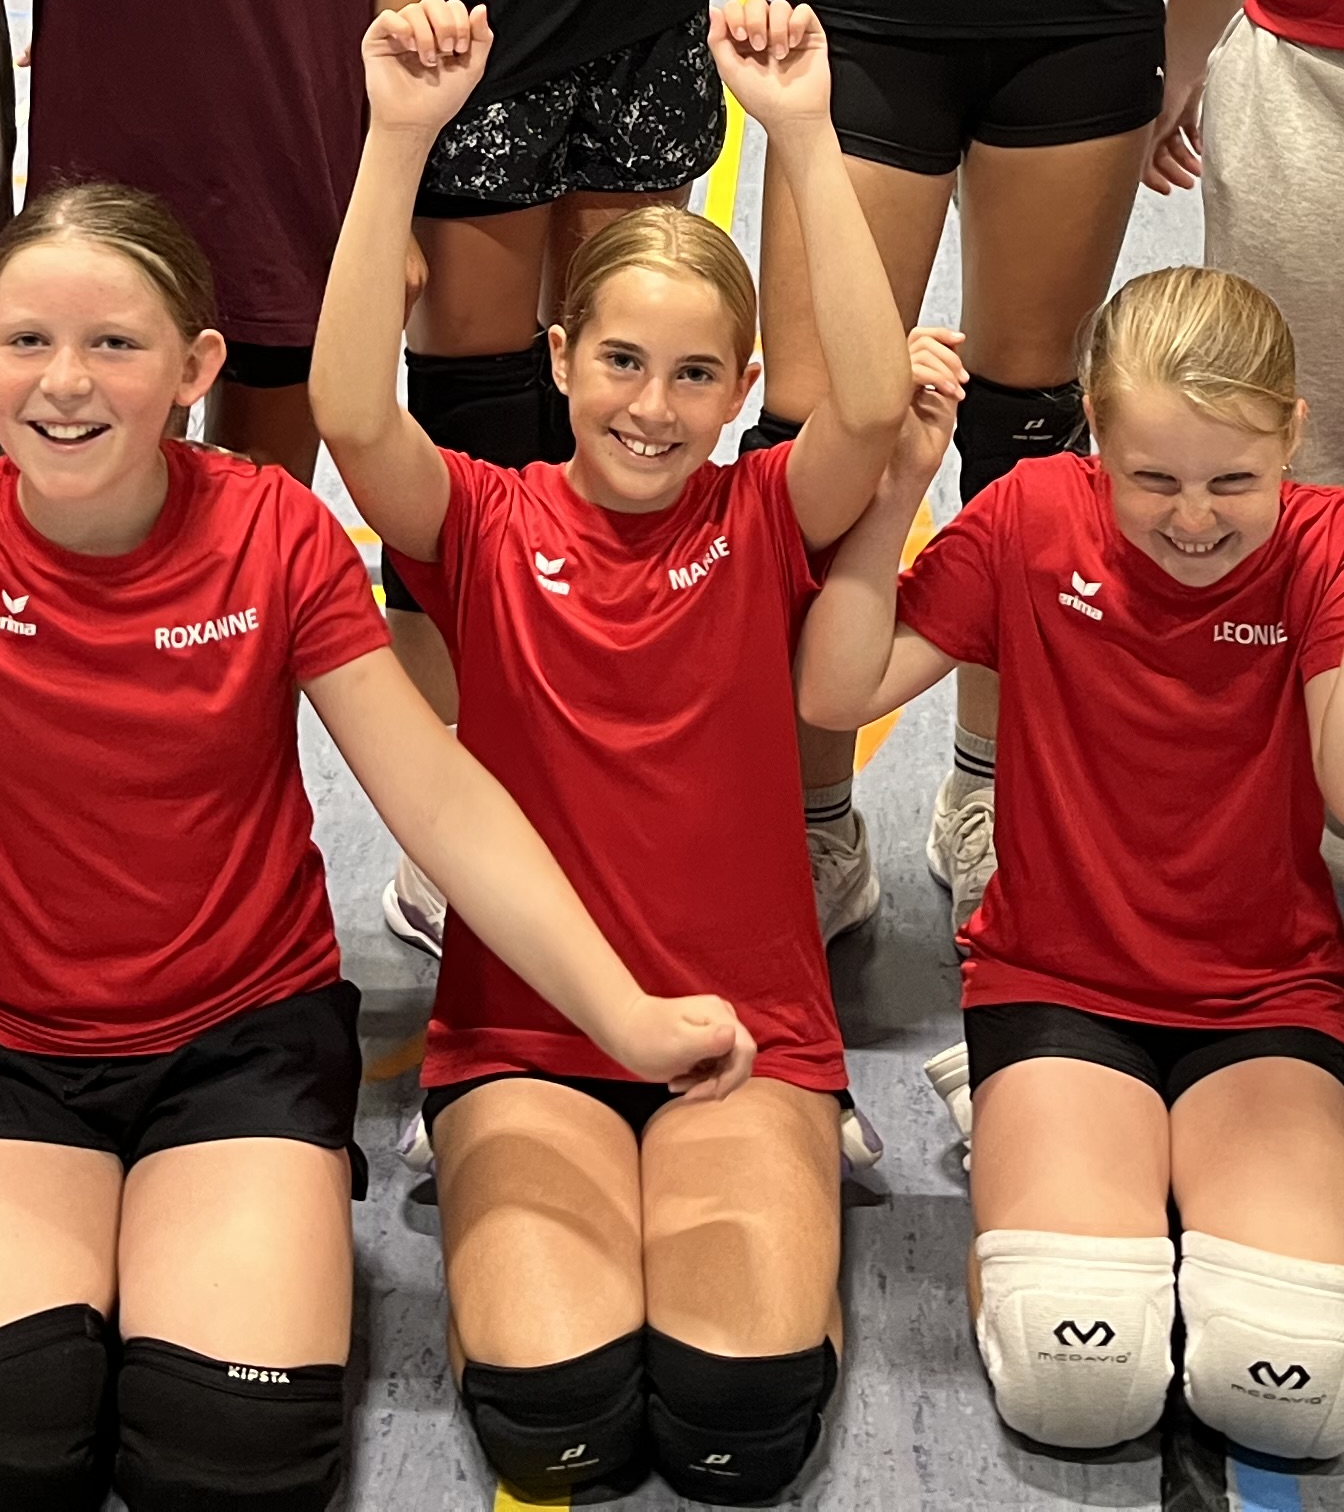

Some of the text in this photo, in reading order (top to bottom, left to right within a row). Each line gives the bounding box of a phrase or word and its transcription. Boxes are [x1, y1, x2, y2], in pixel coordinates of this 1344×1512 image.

[1058, 592, 1103, 621] erima
[154, 607, 259, 650] ROXANNE
[1213, 621, 1288, 646] LEONIE
[227, 1365, 291, 1384] KIPSTA
